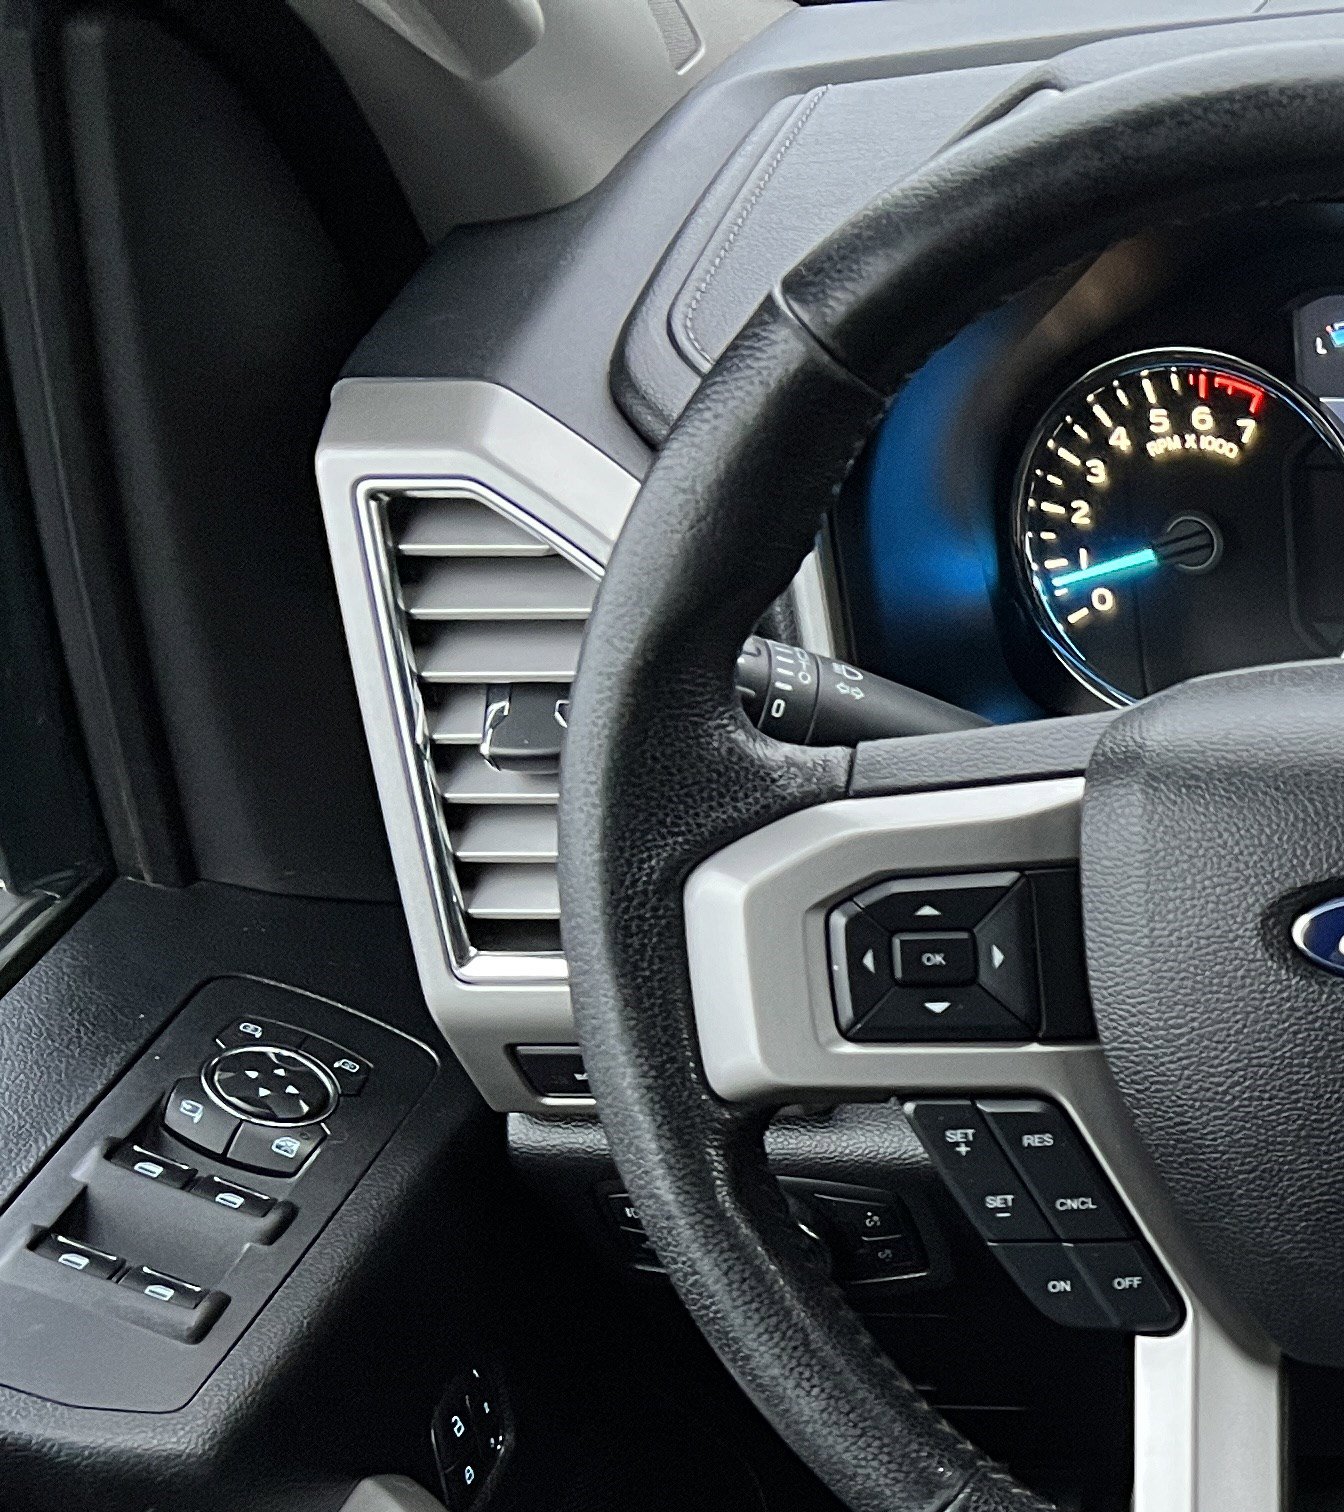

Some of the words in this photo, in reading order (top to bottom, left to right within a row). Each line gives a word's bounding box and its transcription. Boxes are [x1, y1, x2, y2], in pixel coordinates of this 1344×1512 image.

[1315, 337, 1328, 355] L
[1149, 408, 1170, 433] 5
[1191, 405, 1215, 431] 6
[1108, 426, 1131, 451] 4
[1236, 417, 1257, 444] 7
[1146, 434, 1182, 457] RPM
[1184, 433, 1197, 449] X
[1199, 434, 1239, 459] 1000
[1085, 459, 1107, 484] 3
[1070, 500, 1092, 525] 2
[1091, 588, 1113, 611] 0
[921, 952, 946, 967] OK
[945, 1128, 975, 1144] SET
[1022, 1133, 1054, 1149] RES
[985, 1194, 1015, 1209] SET
[1055, 1196, 1098, 1211] CNCL
[1047, 1280, 1072, 1293] ON
[1113, 1276, 1143, 1291] OFF
